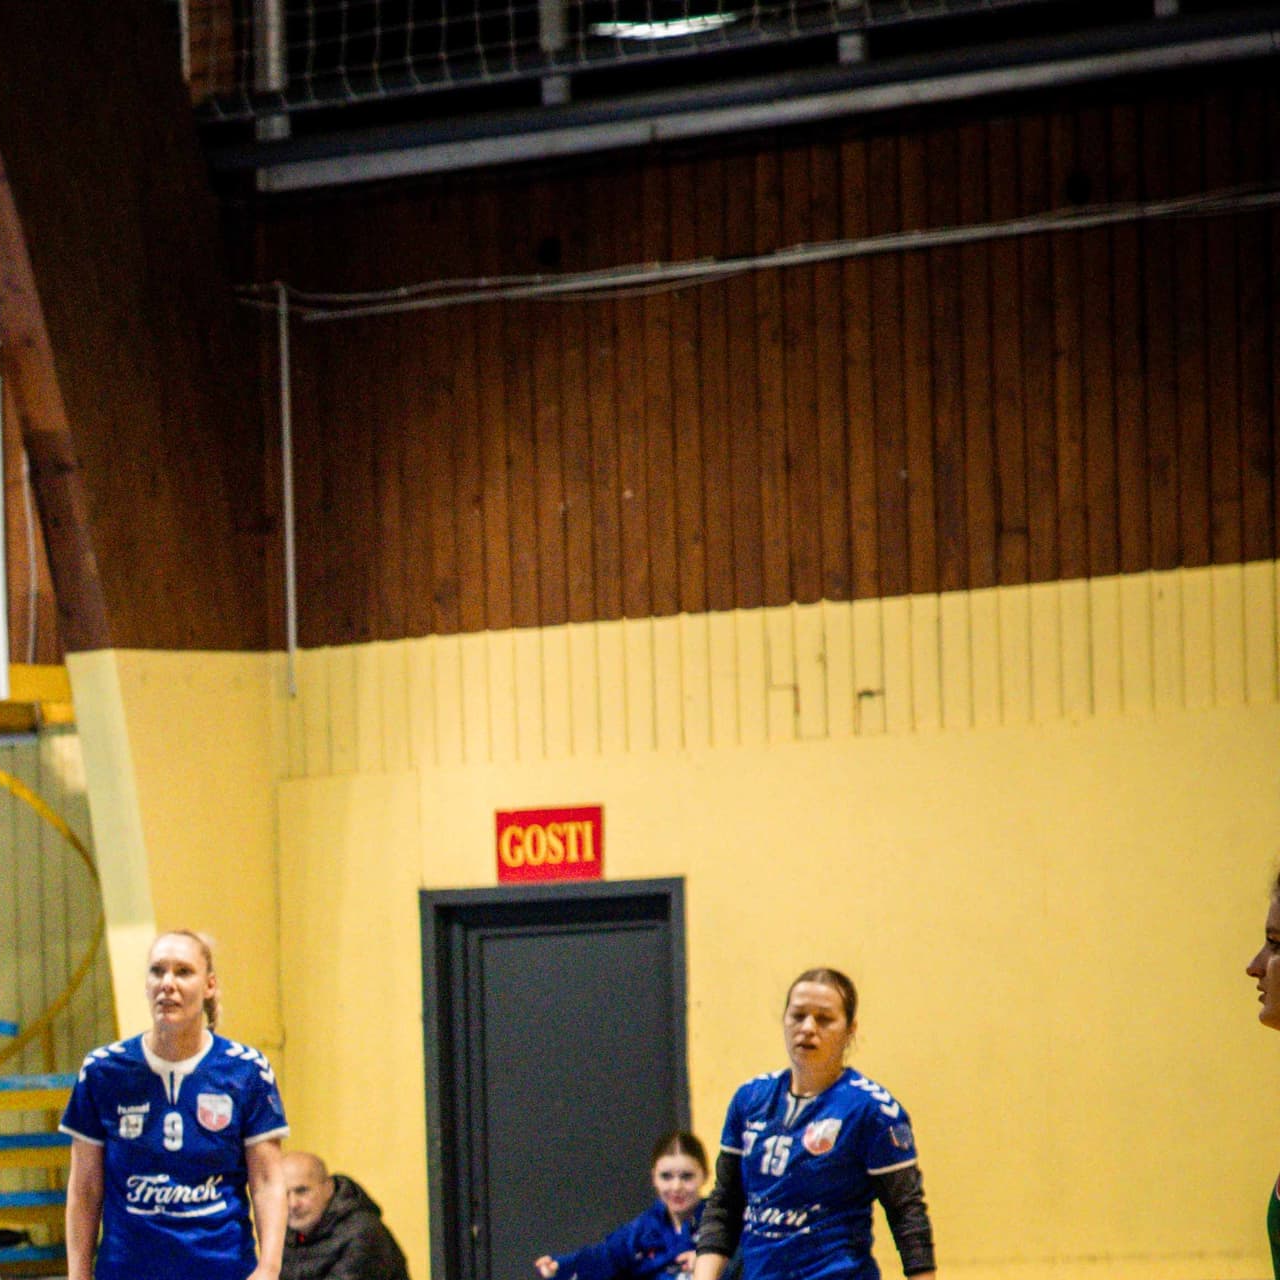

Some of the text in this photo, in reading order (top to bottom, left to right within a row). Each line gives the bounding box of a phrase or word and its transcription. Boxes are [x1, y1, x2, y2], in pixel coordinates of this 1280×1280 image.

[501, 820, 594, 868] GOSTI
[163, 1111, 184, 1151] 9
[760, 1135, 793, 1176] 15
[126, 1174, 224, 1204] Franck
